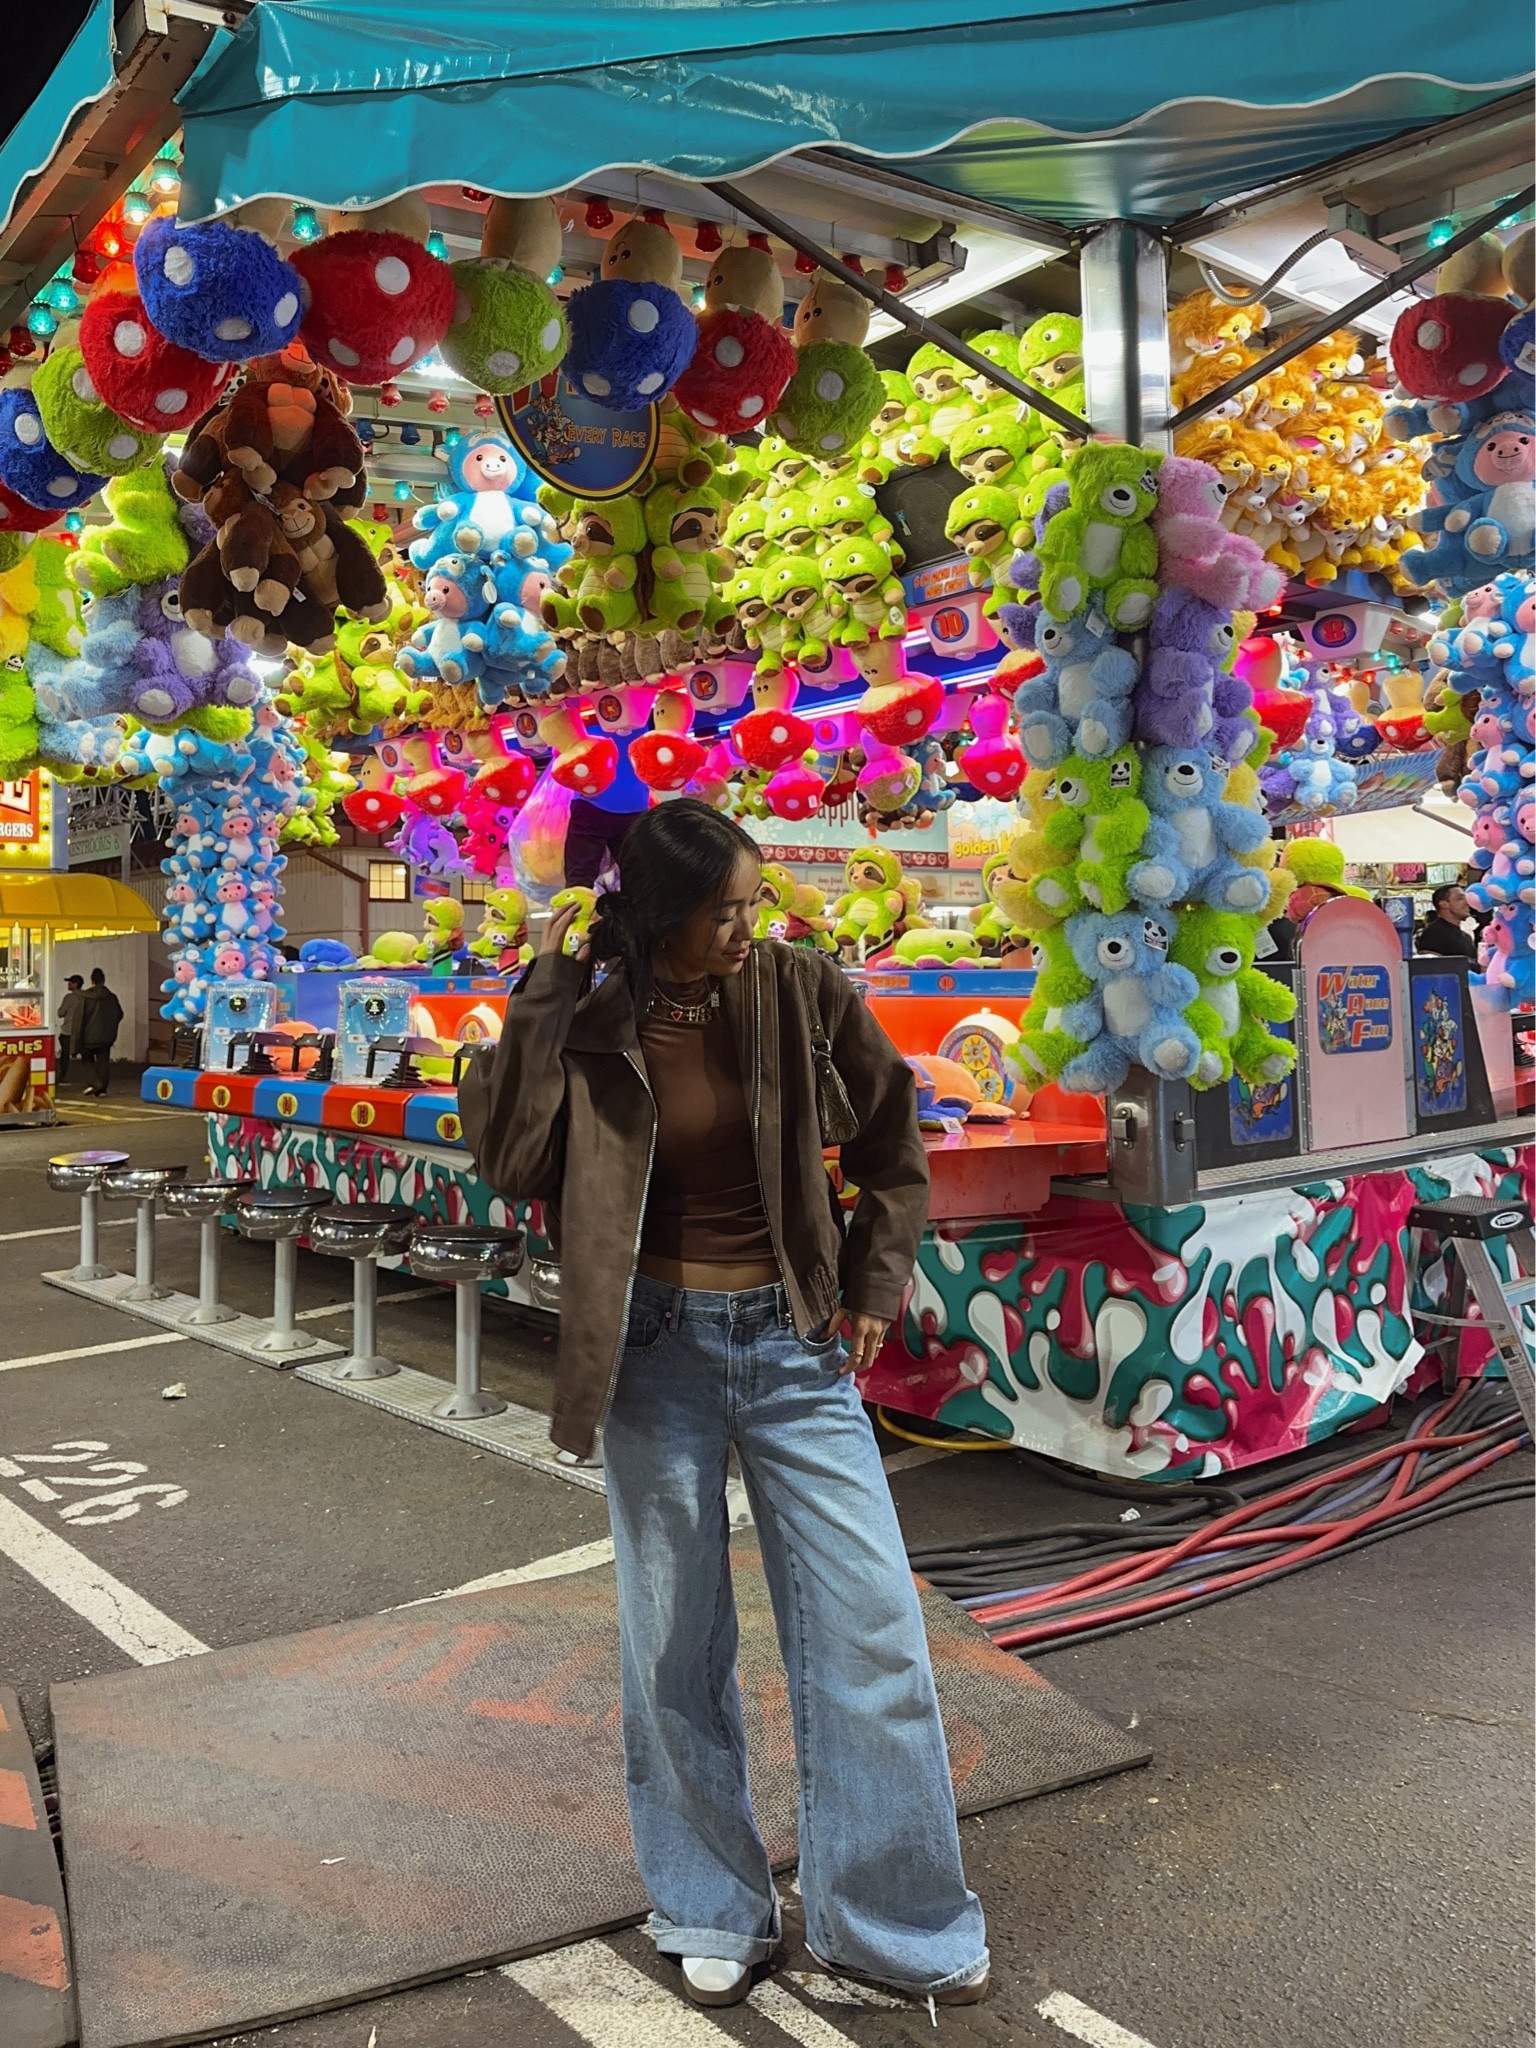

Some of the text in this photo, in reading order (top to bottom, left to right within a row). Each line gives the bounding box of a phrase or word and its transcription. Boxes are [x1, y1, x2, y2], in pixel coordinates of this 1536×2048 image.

[567, 424, 647, 449] EVERY RACE
[936, 610, 964, 639] 10
[1322, 618, 1347, 643] 8
[694, 676, 713, 697] 12
[69, 835, 111, 857] ESTROOMS
[954, 836, 999, 859] golden
[1319, 966, 1380, 1001] Water
[1345, 993, 1389, 1017] Race
[1350, 1019, 1389, 1047] Fun
[0, 1039, 43, 1055] FRIES
[442, 1116, 457, 1139] 12
